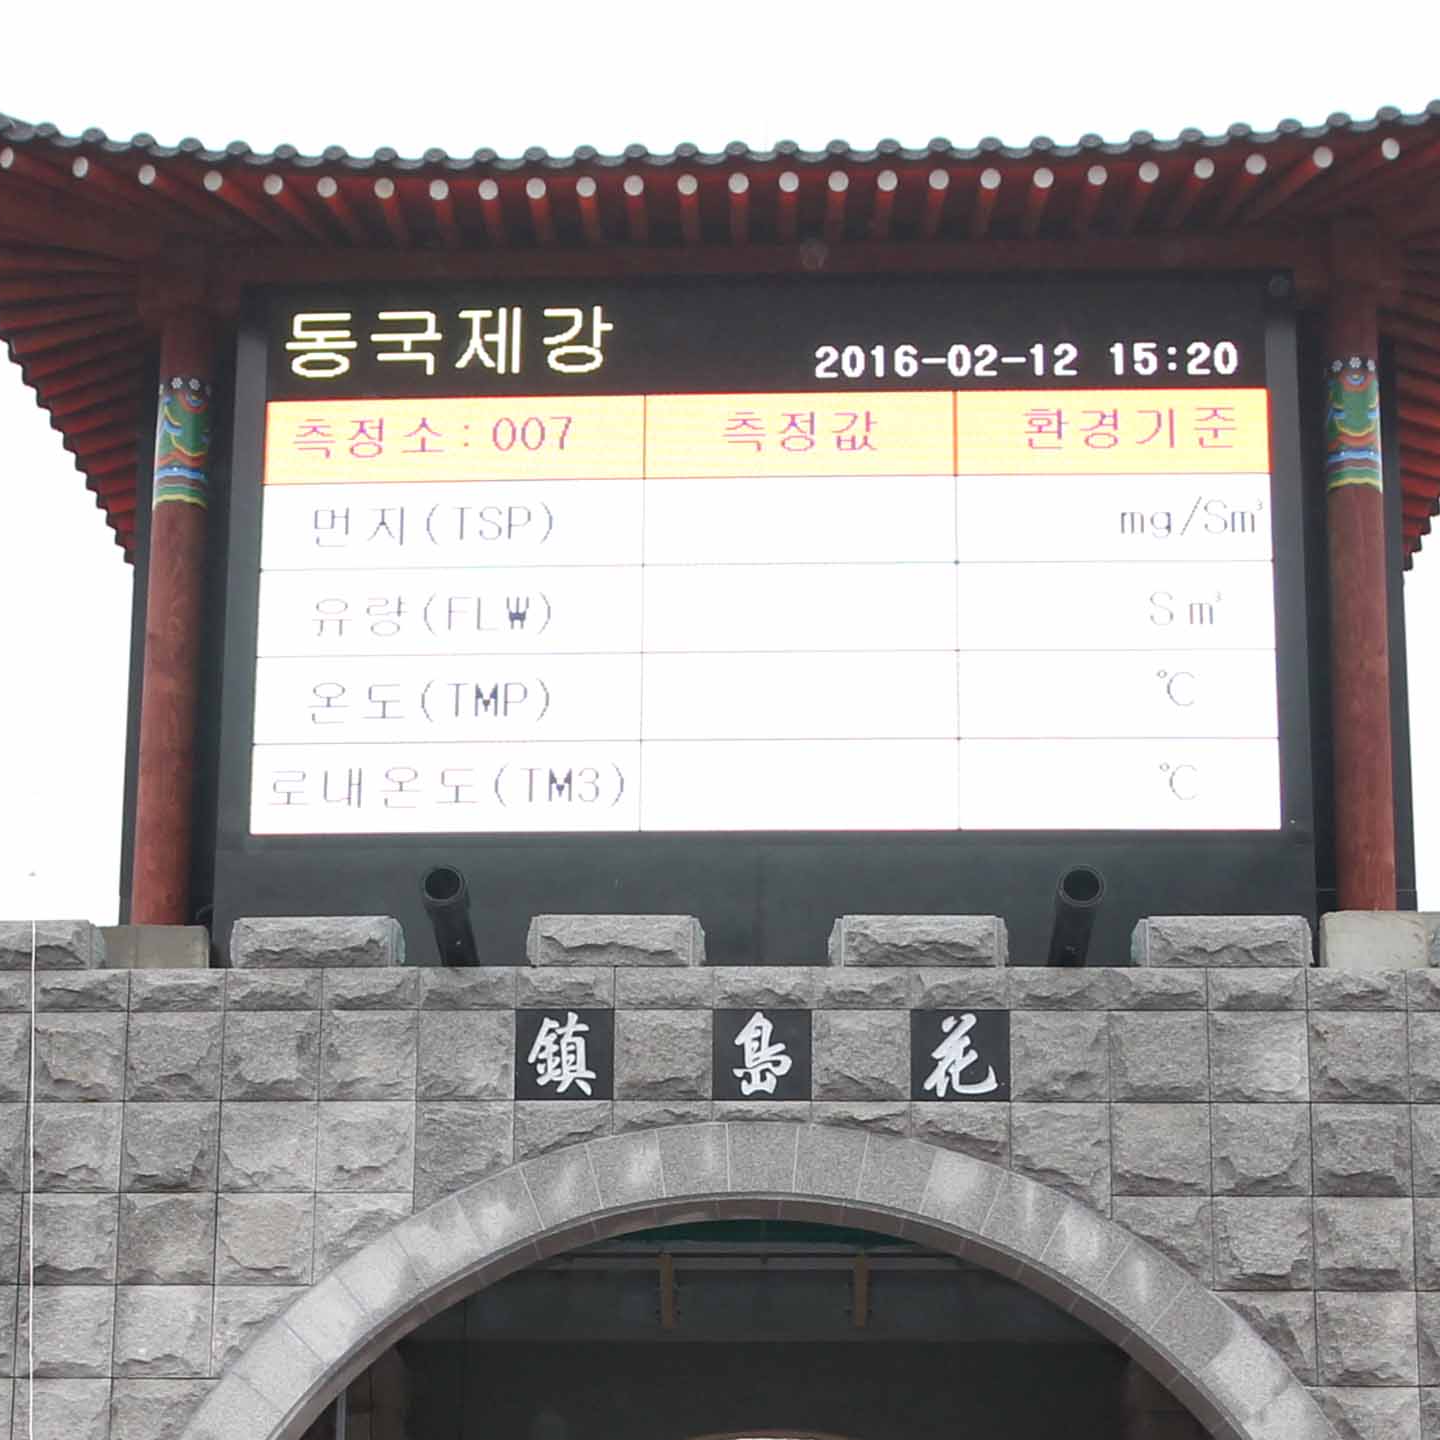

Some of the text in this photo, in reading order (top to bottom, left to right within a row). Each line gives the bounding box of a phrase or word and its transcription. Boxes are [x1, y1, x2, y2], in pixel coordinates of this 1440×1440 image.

[285, 305, 613, 378] 동국제강
[814, 341, 1239, 378] 2016-02-12 15:20
[722, 410, 878, 453] 측정값
[1023, 406, 1237, 449] 환경기준
[312, 502, 555, 548] 먼지(TSP)
[307, 678, 550, 724] 온도(TMP)
